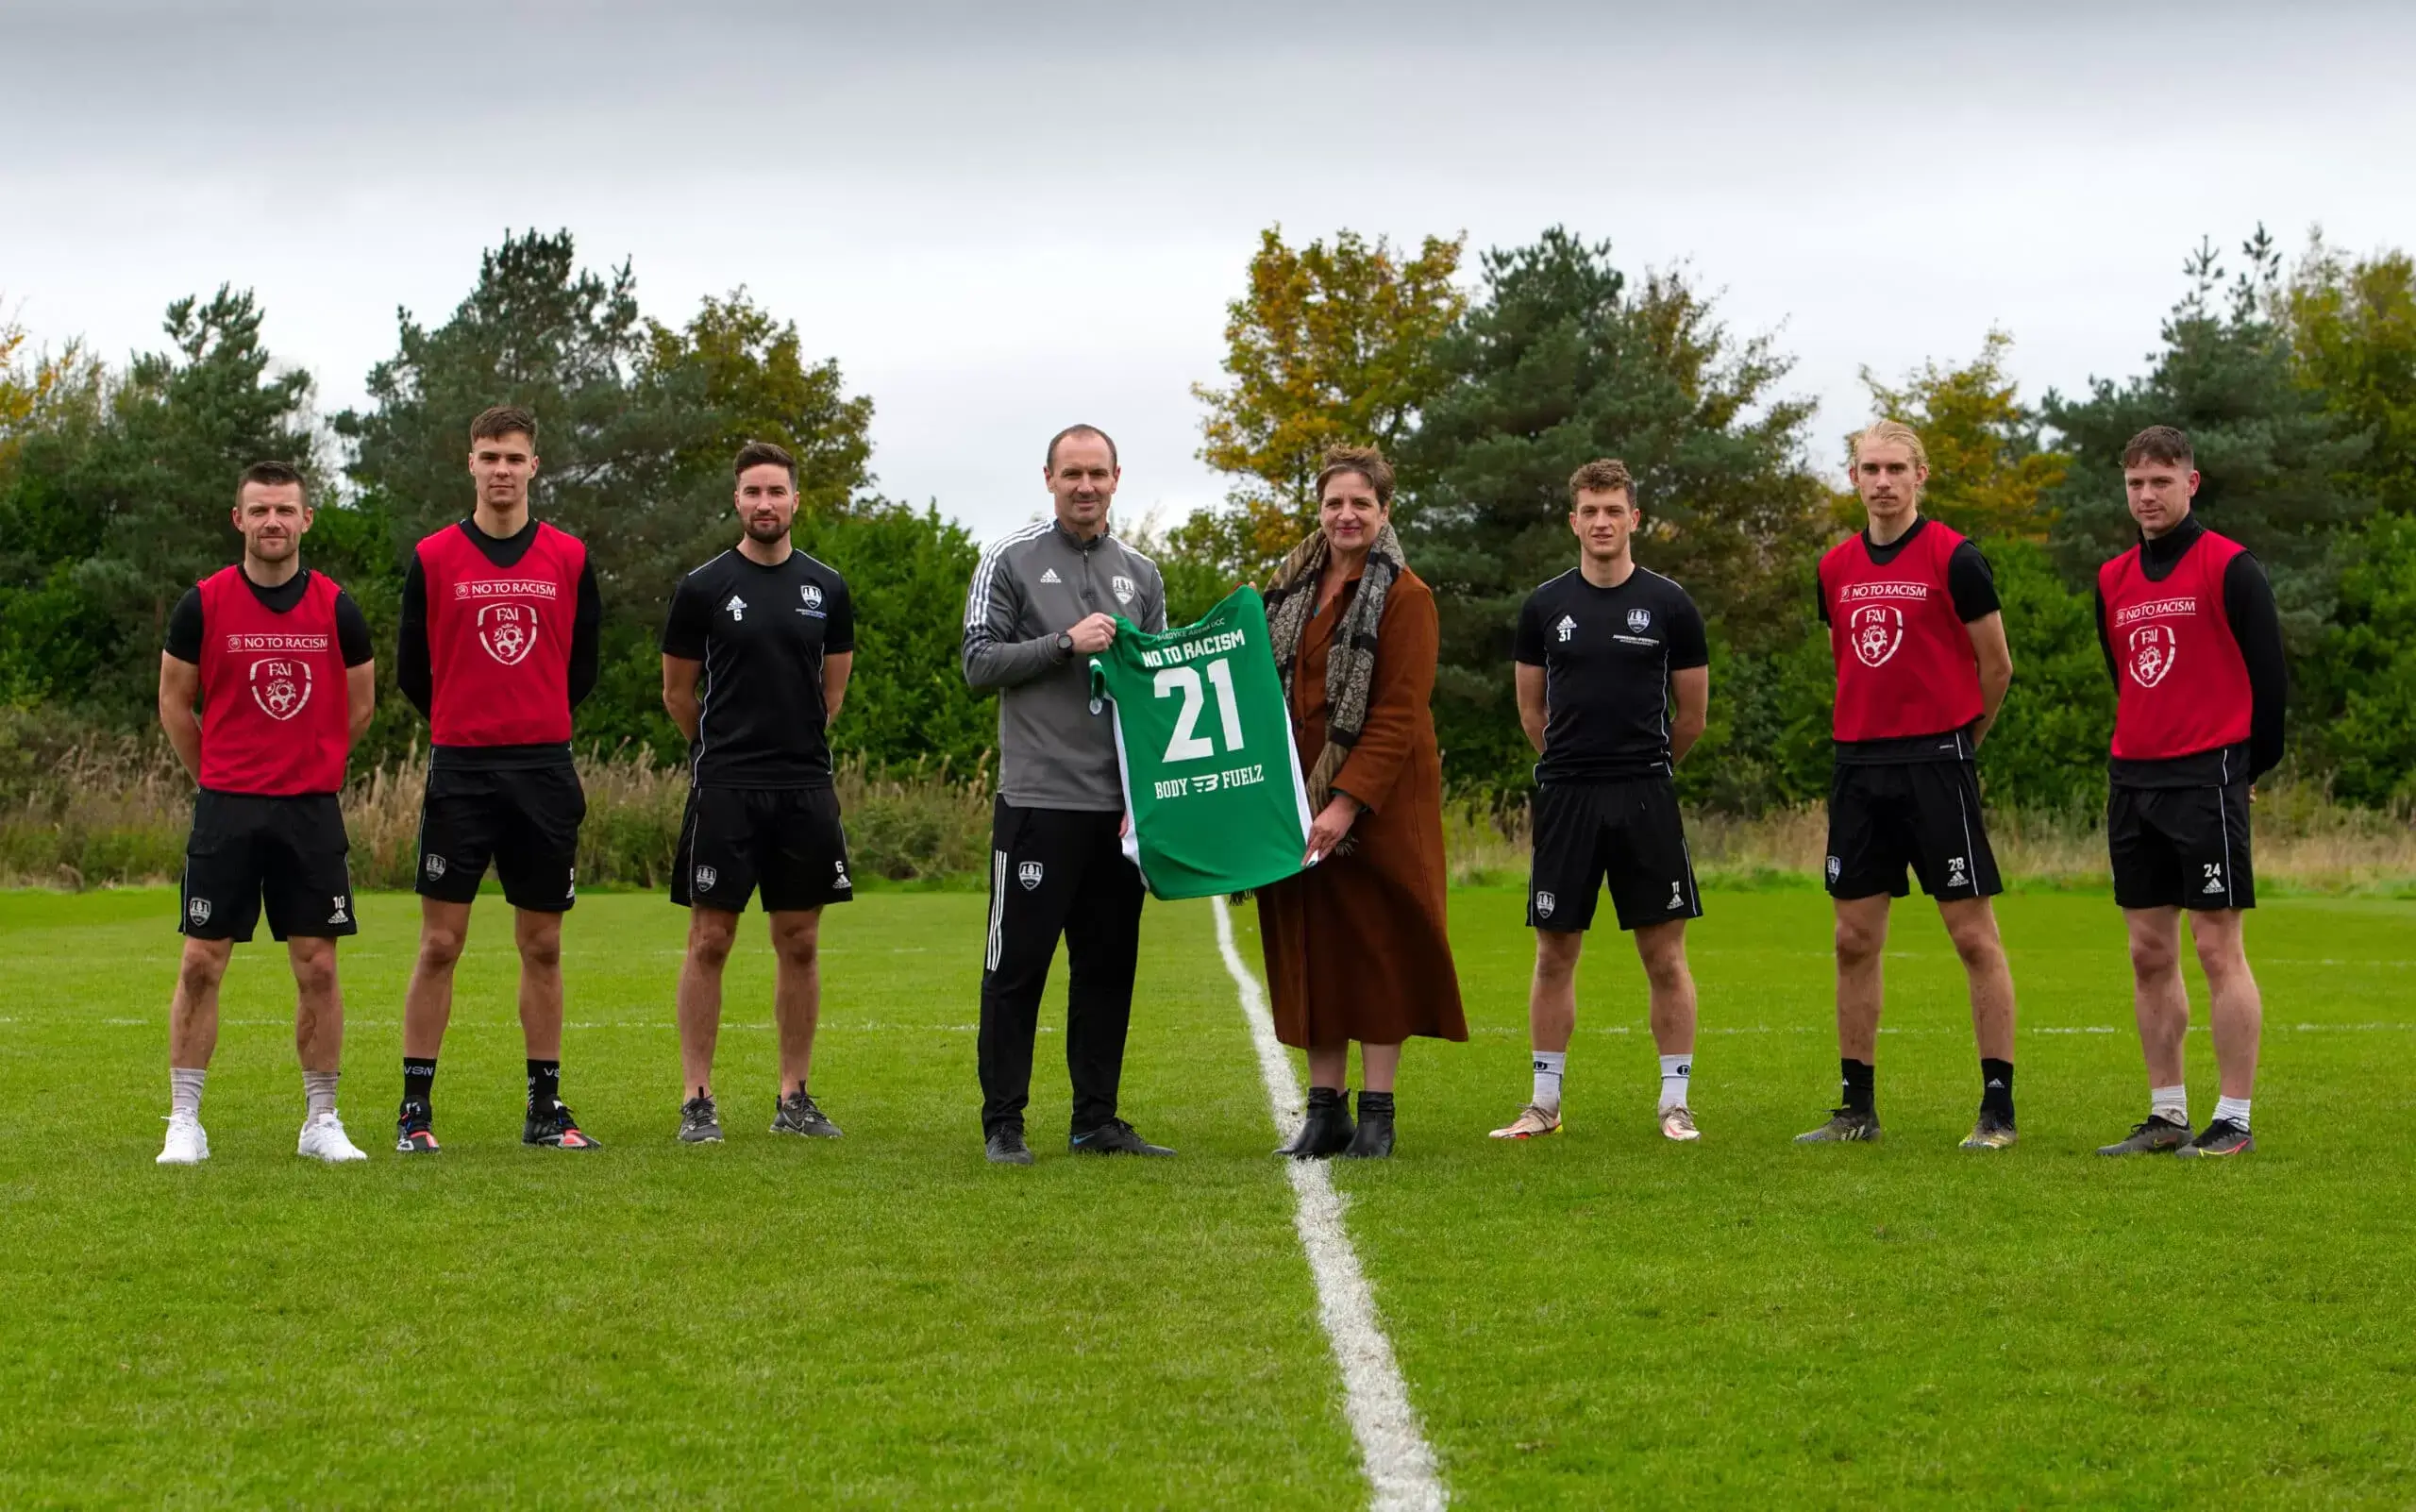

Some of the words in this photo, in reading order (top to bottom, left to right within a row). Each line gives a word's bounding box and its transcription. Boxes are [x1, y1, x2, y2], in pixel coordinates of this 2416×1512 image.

[471, 583, 492, 595] NO
[493, 583, 511, 594] TO
[512, 583, 556, 596] RACISM
[1852, 586, 1869, 597] NO
[1871, 585, 1885, 596] TO
[1885, 585, 1927, 597] RACISM
[495, 608, 519, 622] FAI
[733, 609, 743, 621] 6
[1866, 609, 1887, 623] FAI
[2126, 608, 2140, 620] NO
[2141, 605, 2156, 616] TO
[2156, 600, 2196, 613] RACISM
[244, 637, 264, 648] NO
[265, 637, 283, 647] TO
[285, 637, 327, 648] RACISM
[1558, 629, 1571, 642] 31
[2140, 628, 2158, 645] FAI
[1141, 650, 1164, 667] NO
[1163, 646, 1183, 664] TO
[1183, 629, 1246, 660] RACISM
[268, 663, 293, 677] FAI
[1153, 657, 1245, 763] 21
[1154, 778, 1188, 799] BODY
[1221, 764, 1265, 789] FUELZ
[834, 860, 845, 873] 6
[1948, 857, 1965, 872] 28
[2203, 862, 2222, 878] 24
[1671, 881, 1680, 894] 11
[332, 896, 345, 909] 10
[404, 1066, 434, 1076] VSN
